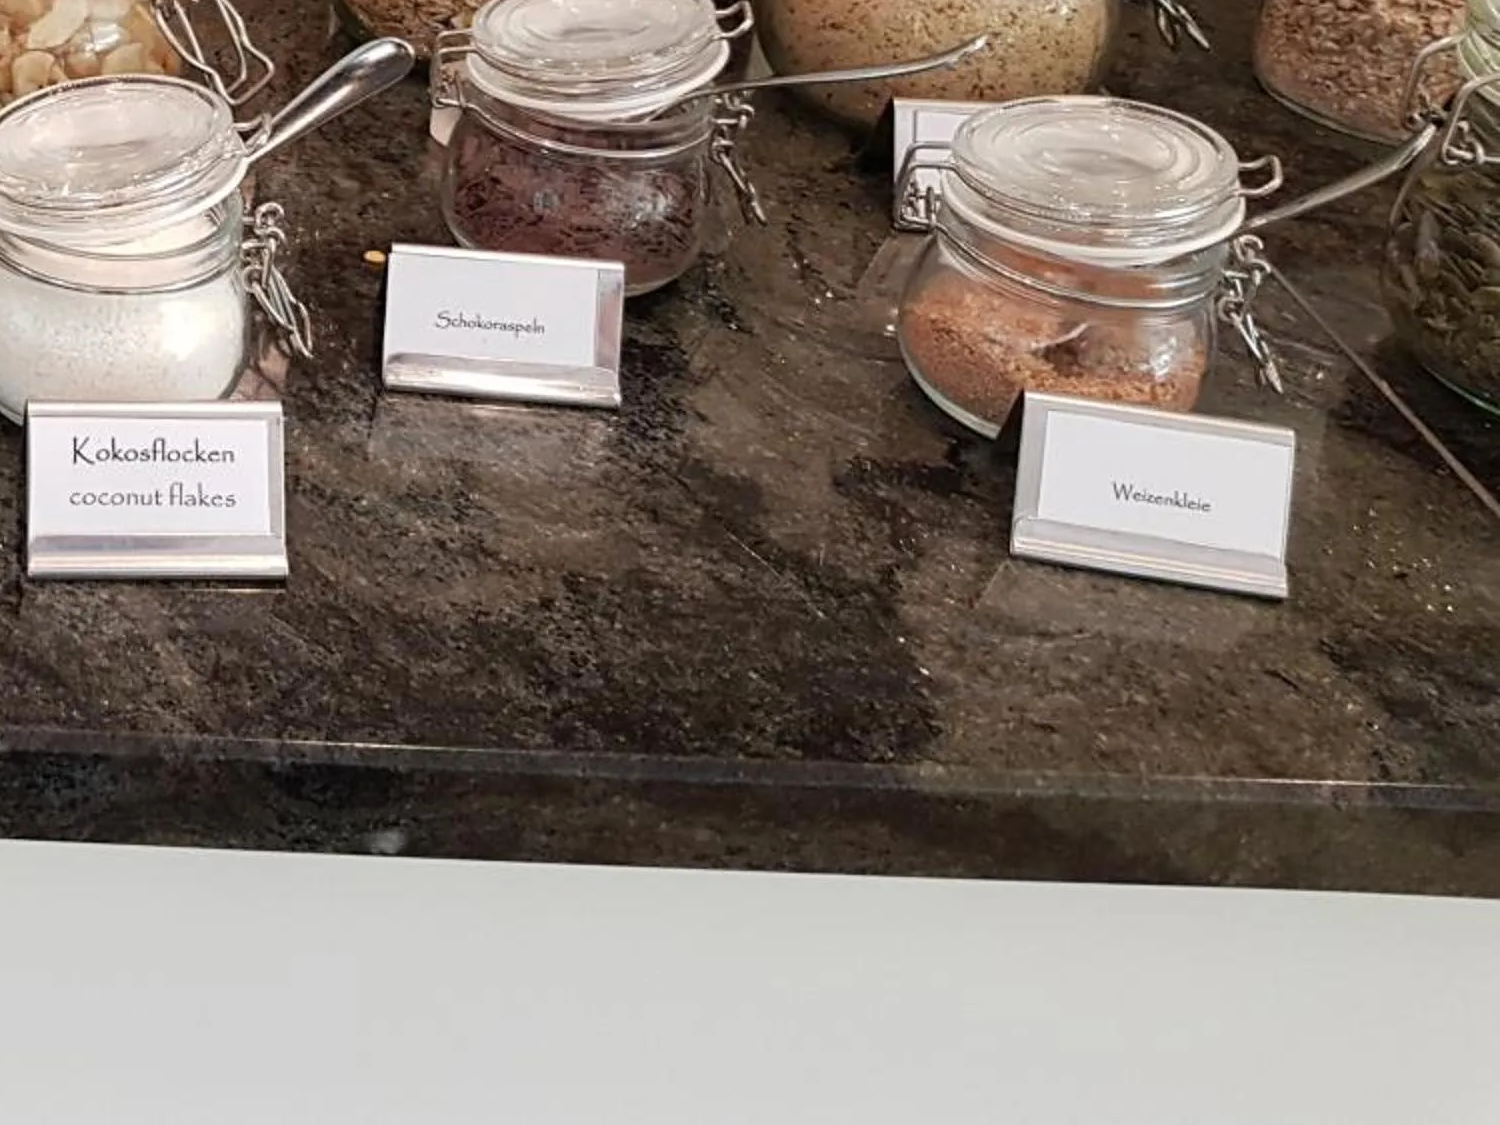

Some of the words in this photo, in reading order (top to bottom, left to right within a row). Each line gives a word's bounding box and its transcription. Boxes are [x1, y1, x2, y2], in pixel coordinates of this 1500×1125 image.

[435, 309, 546, 340] Schokoraspeln
[72, 436, 236, 466] Kokosflocken
[69, 488, 163, 507] coconut
[168, 481, 237, 509] flakes
[1112, 481, 1213, 513] Weizenkleie
